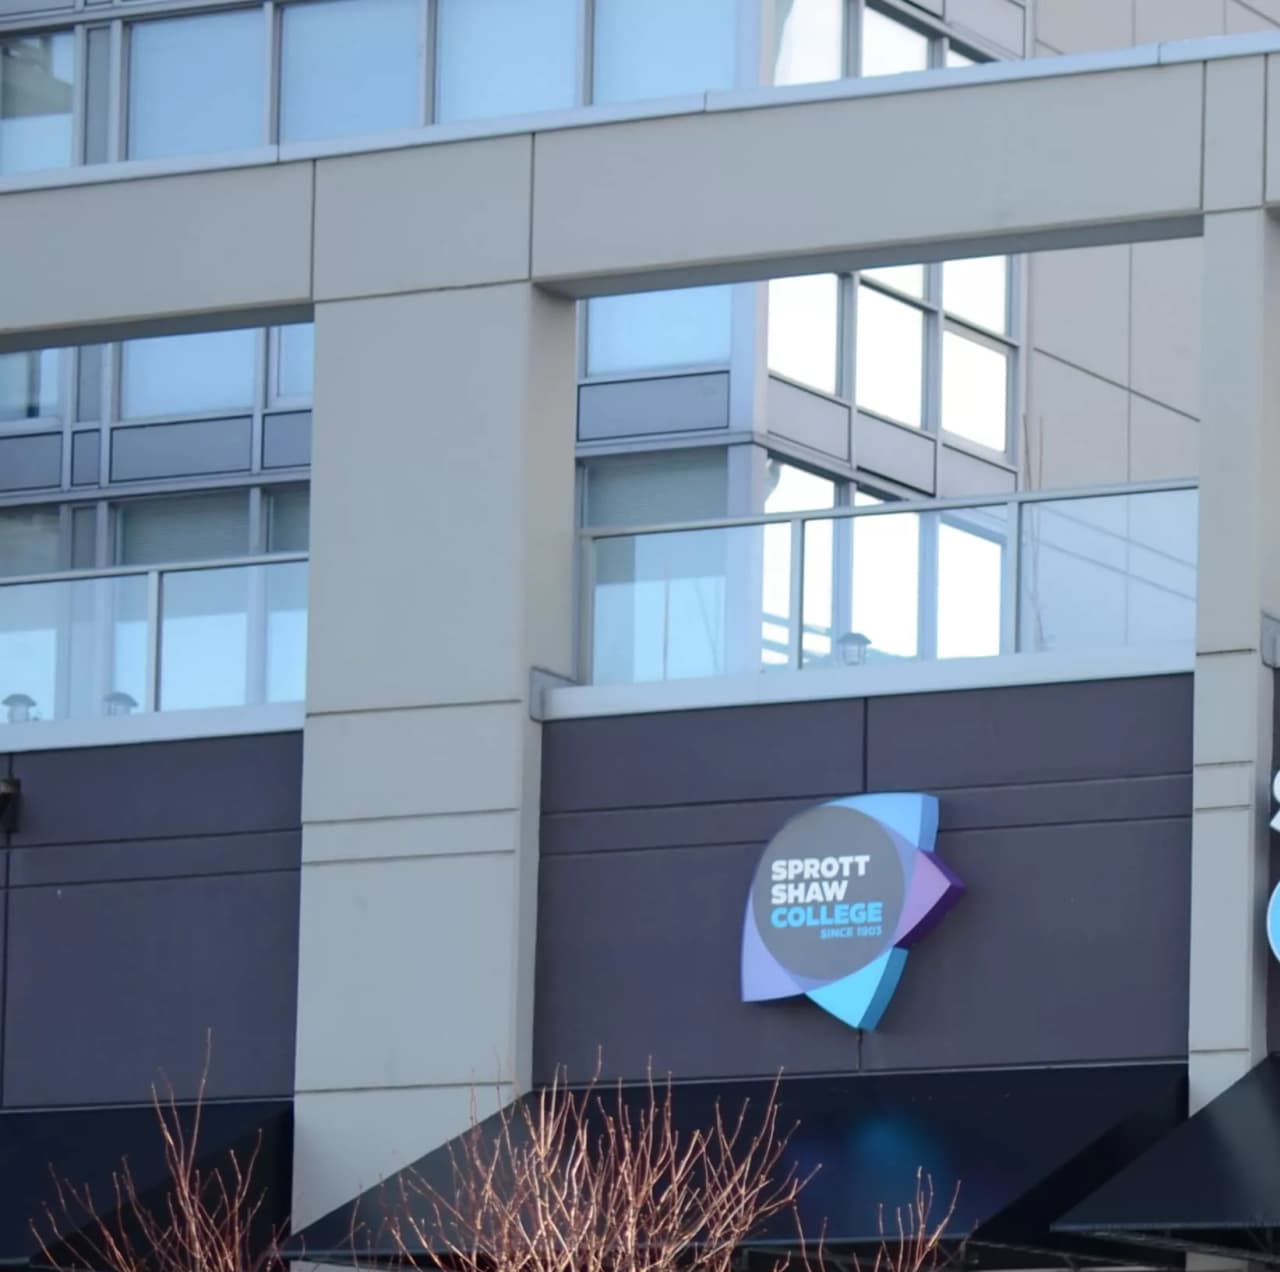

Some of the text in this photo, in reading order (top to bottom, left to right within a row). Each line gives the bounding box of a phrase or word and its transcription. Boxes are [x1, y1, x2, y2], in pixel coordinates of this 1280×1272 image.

[771, 855, 870, 881] SPROTT
[771, 880, 849, 904] SHAW
[770, 901, 884, 928] COLLEGE
[820, 927, 853, 939] SINCE
